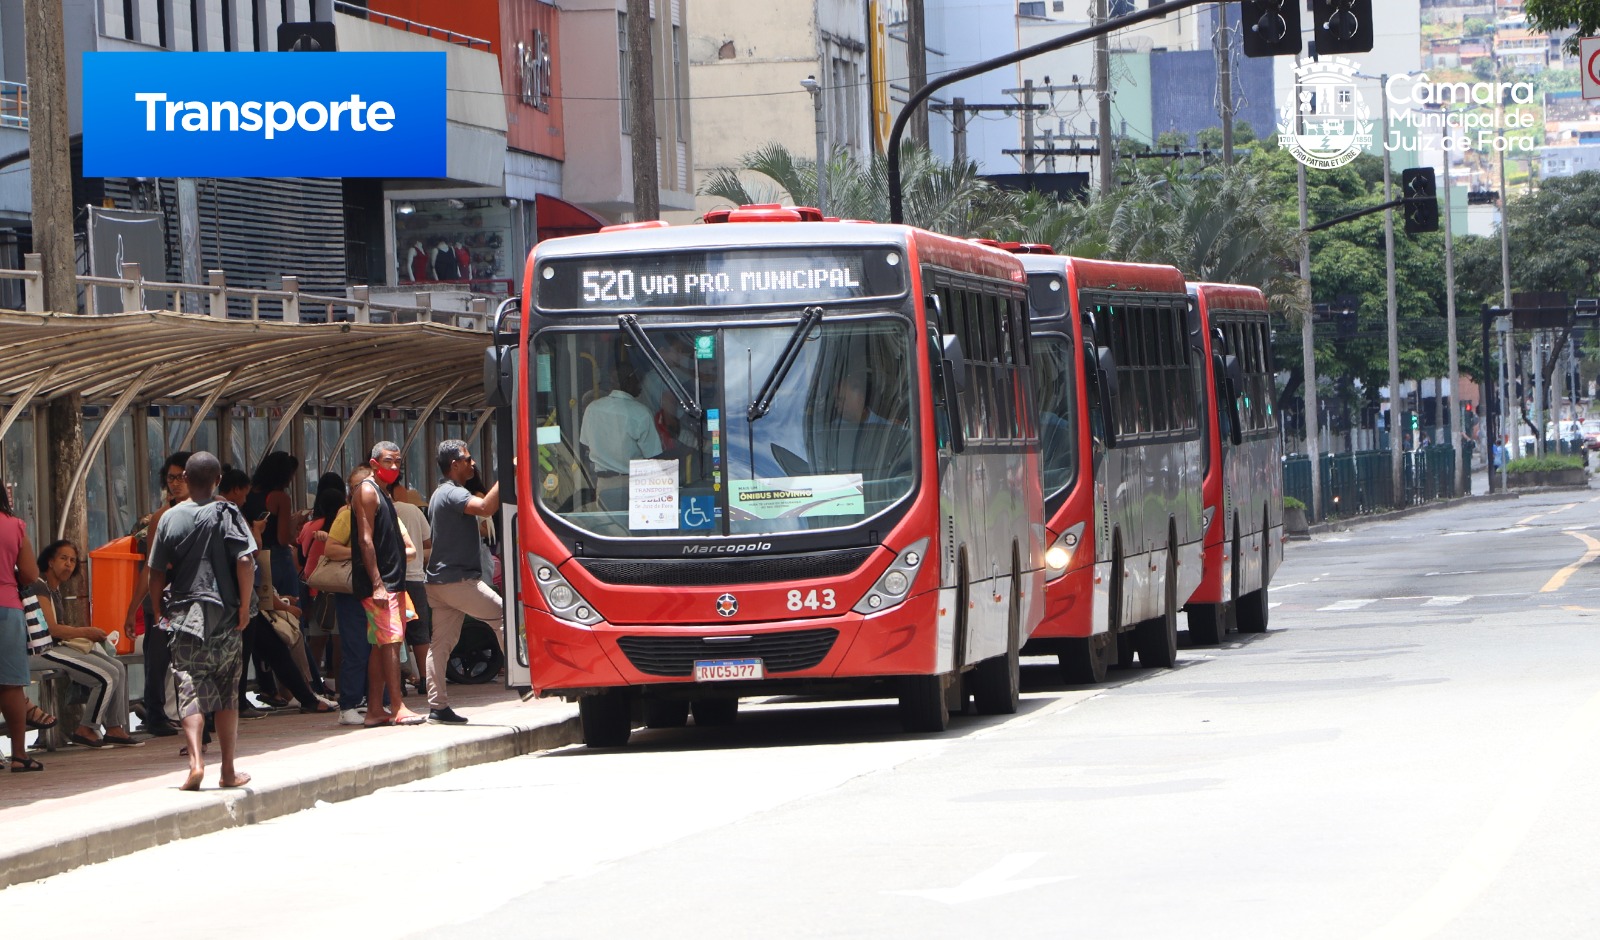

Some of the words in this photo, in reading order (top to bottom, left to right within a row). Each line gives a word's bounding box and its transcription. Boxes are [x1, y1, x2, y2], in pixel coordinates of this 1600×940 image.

[582, 269, 635, 302] 520
[641, 274, 678, 295] VIA
[741, 268, 860, 292] MUNICIPAL
[740, 490, 772, 501] ÔNIBUS
[682, 541, 772, 555] Marcopolo
[787, 588, 837, 611] 843
[701, 664, 755, 679] RVC5J77
